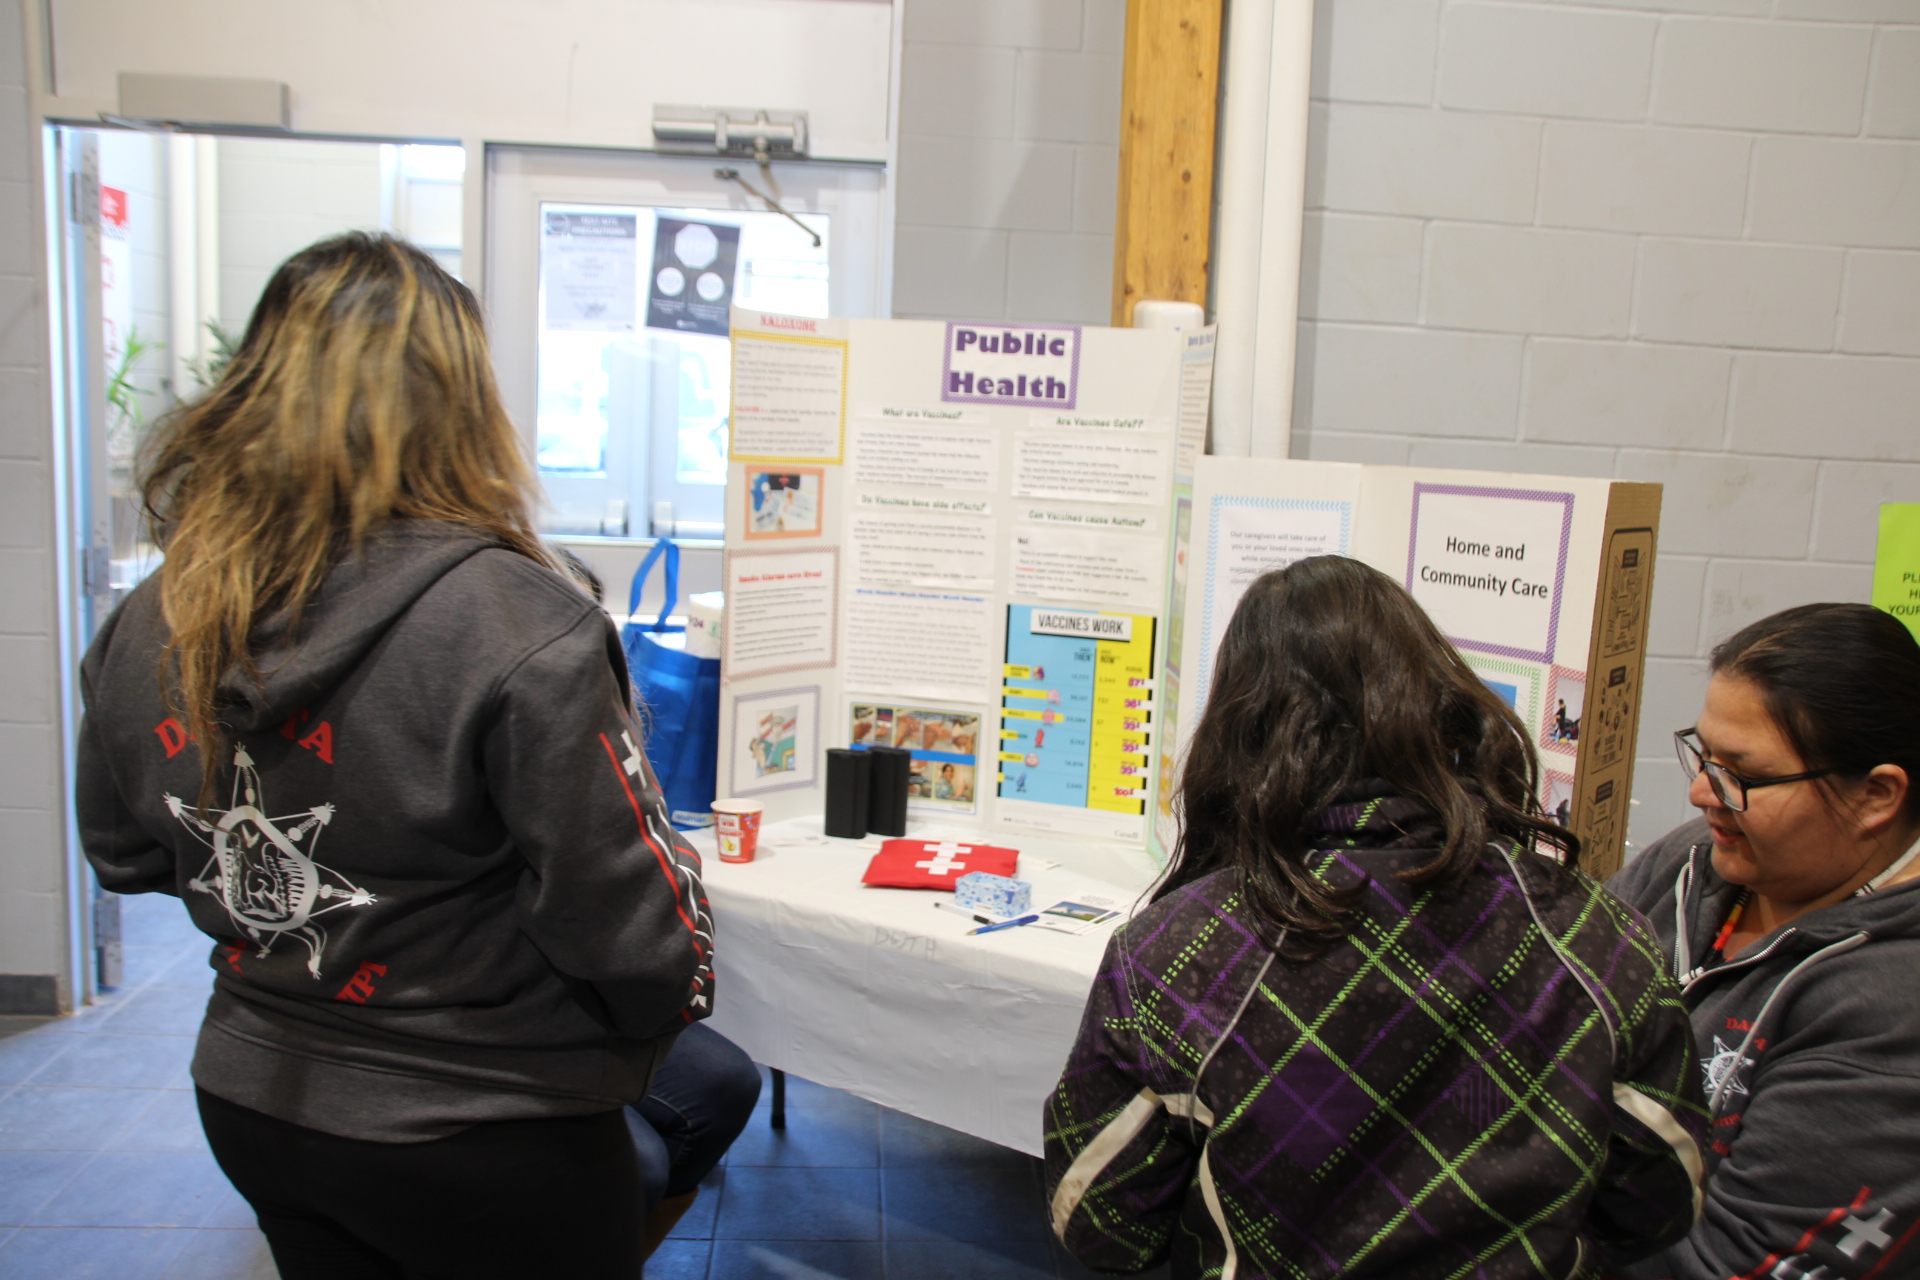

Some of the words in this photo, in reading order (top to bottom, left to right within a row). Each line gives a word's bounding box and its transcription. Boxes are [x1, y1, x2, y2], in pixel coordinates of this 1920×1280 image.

[956, 329, 1065, 357] Public
[950, 371, 1066, 399] Health
[1056, 416, 1071, 426] Are
[1074, 417, 1110, 428] Vaccines
[861, 494, 872, 503] Do
[875, 495, 909, 507] Vaccines
[912, 499, 930, 508] have
[1028, 509, 1044, 519] Can
[1046, 511, 1082, 523] Vaccines
[1085, 516, 1108, 524] cause
[1111, 517, 1146, 528] Autism?
[1446, 535, 1490, 557] Home
[1495, 543, 1525, 561] and
[1421, 565, 1507, 596] Community
[1511, 578, 1548, 598] Care
[1038, 613, 1090, 632] VACCINES
[1092, 619, 1123, 634] WORK
